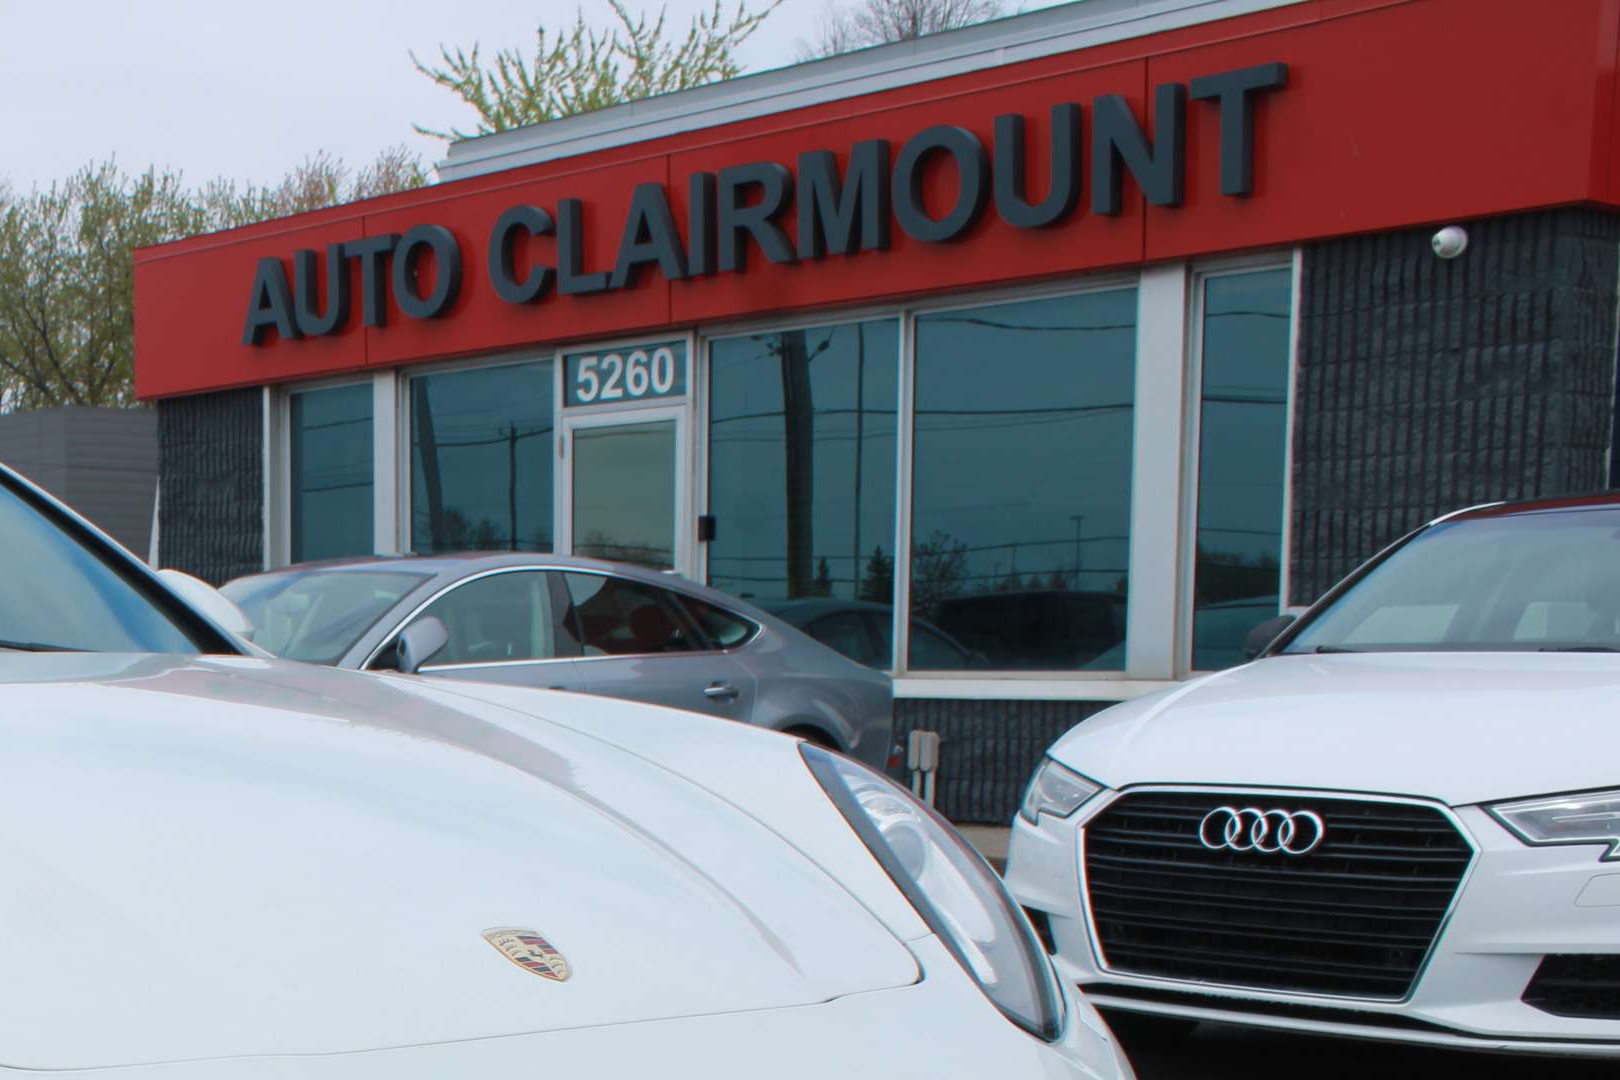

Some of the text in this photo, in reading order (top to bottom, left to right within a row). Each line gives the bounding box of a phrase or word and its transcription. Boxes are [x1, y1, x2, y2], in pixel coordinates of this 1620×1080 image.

[241, 62, 1289, 345] AUTO CLAIRMOUNT
[576, 347, 674, 402] 5260
